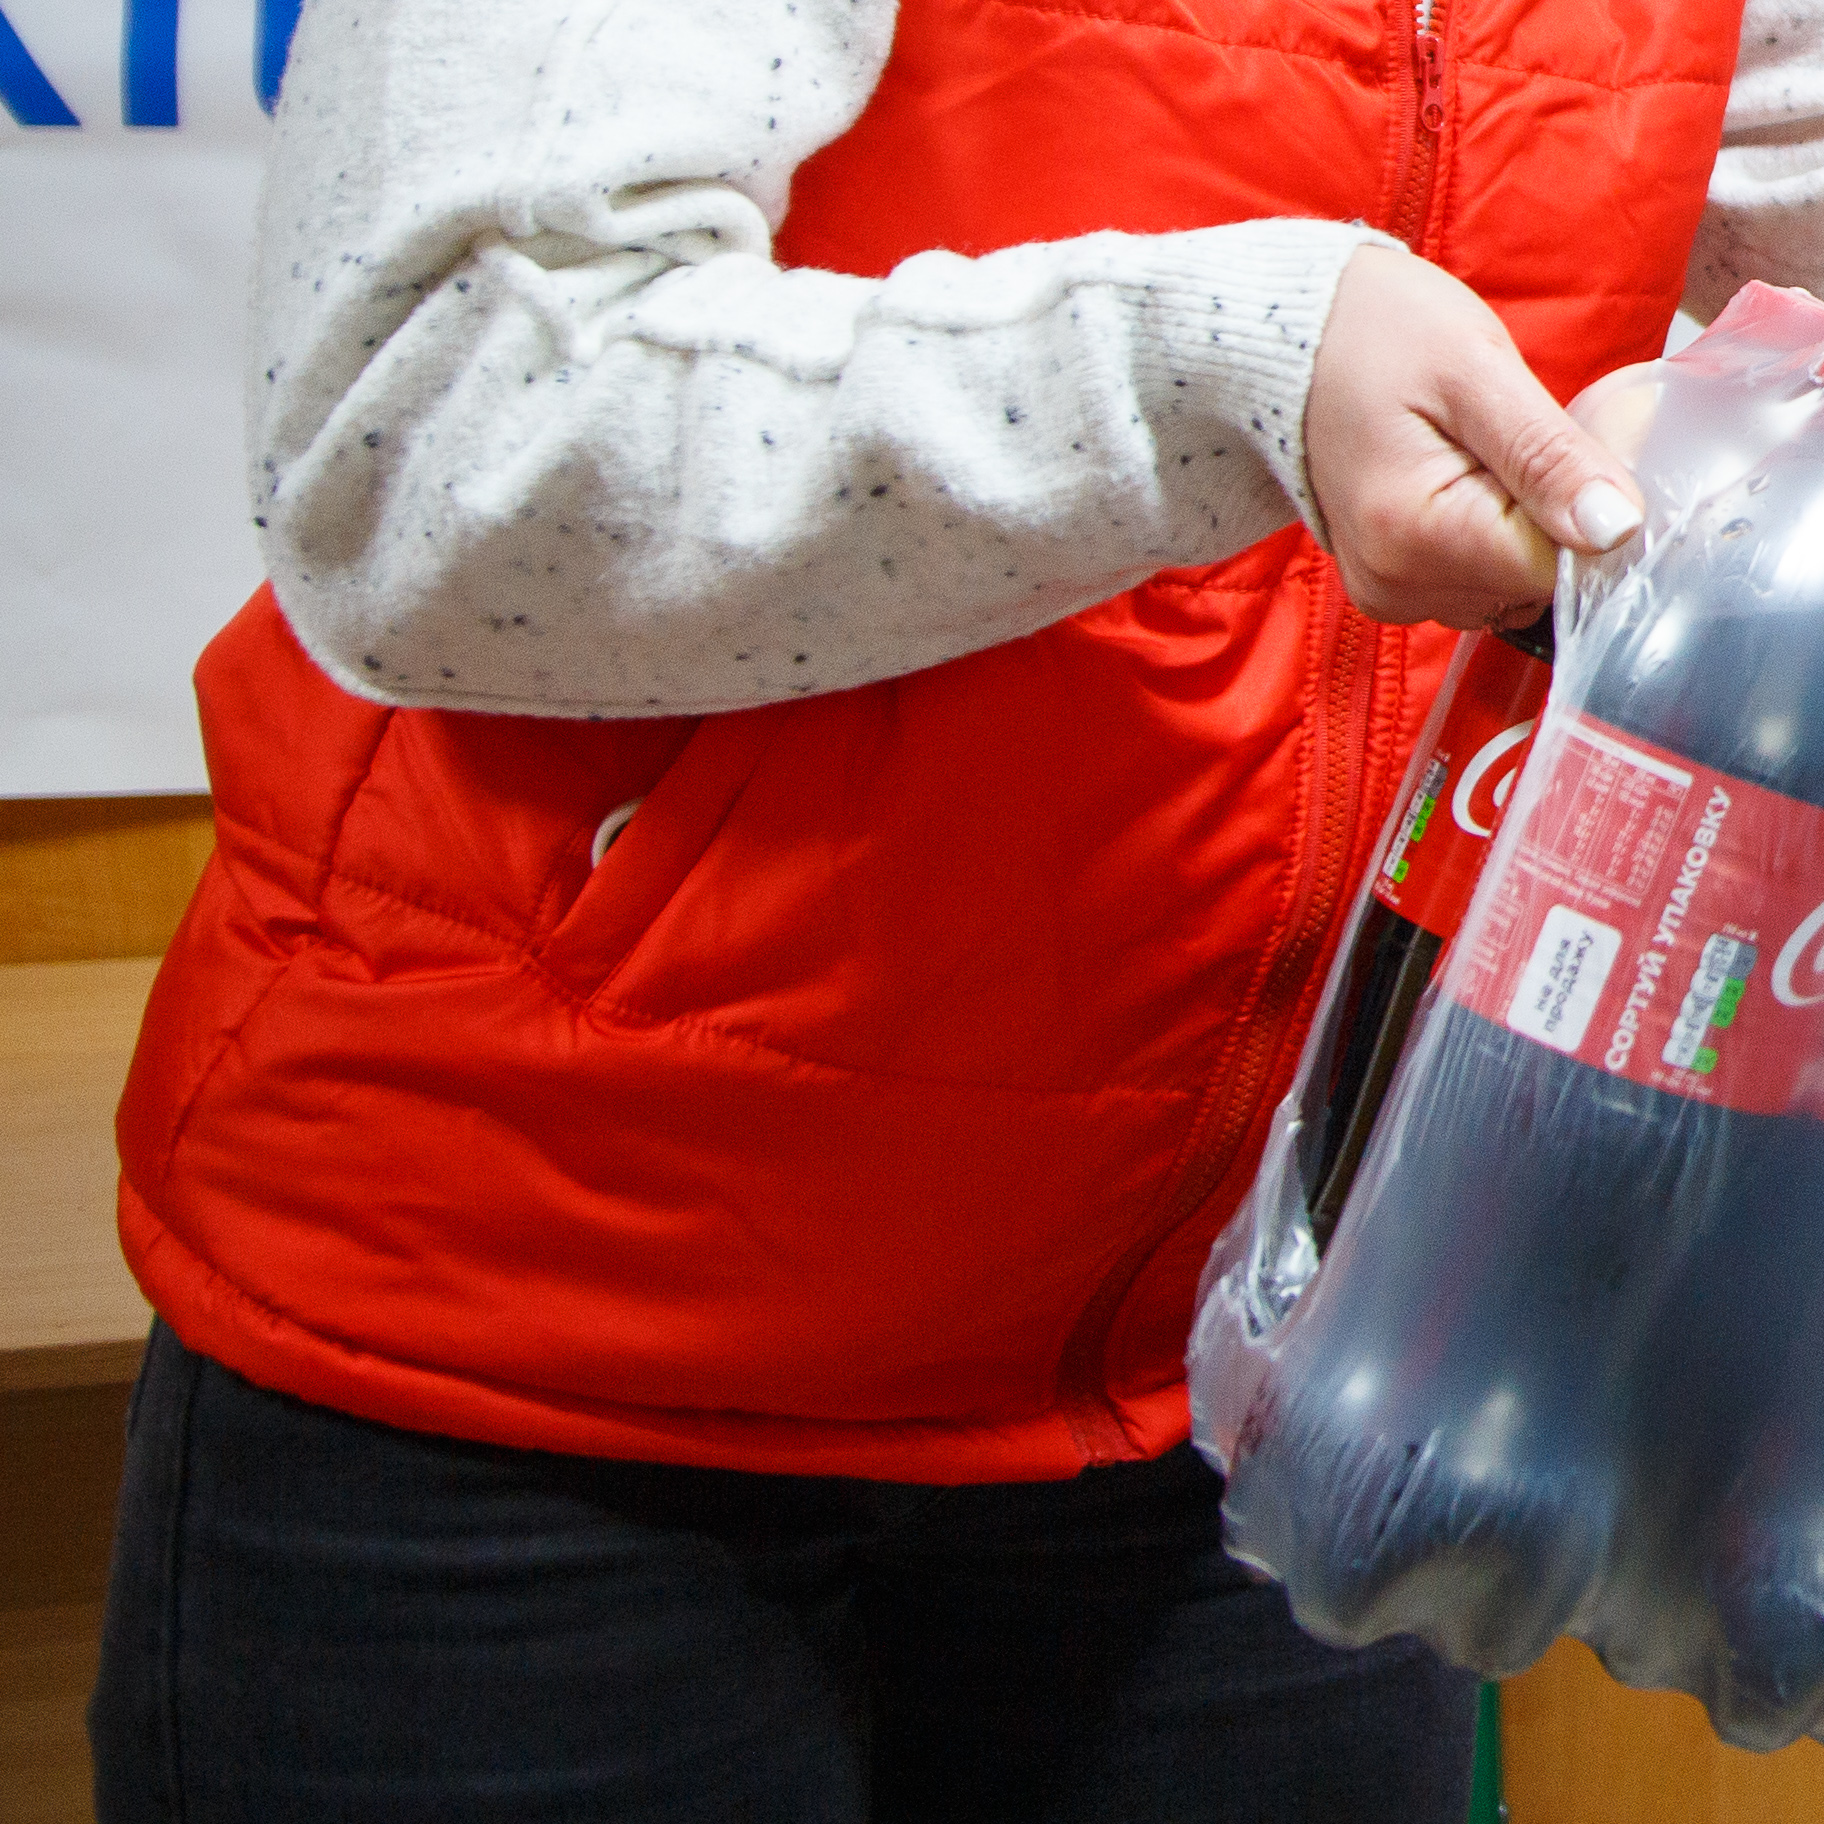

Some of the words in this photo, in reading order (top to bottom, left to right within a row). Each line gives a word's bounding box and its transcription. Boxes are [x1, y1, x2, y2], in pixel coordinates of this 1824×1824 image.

[1534, 985, 1553, 1013] не
[1549, 938, 1572, 978] для
[1543, 928, 1596, 1034] продажу
[1603, 949, 1668, 1072] СОРТУЙ
[1652, 786, 1733, 946] УПАКОВКУ
